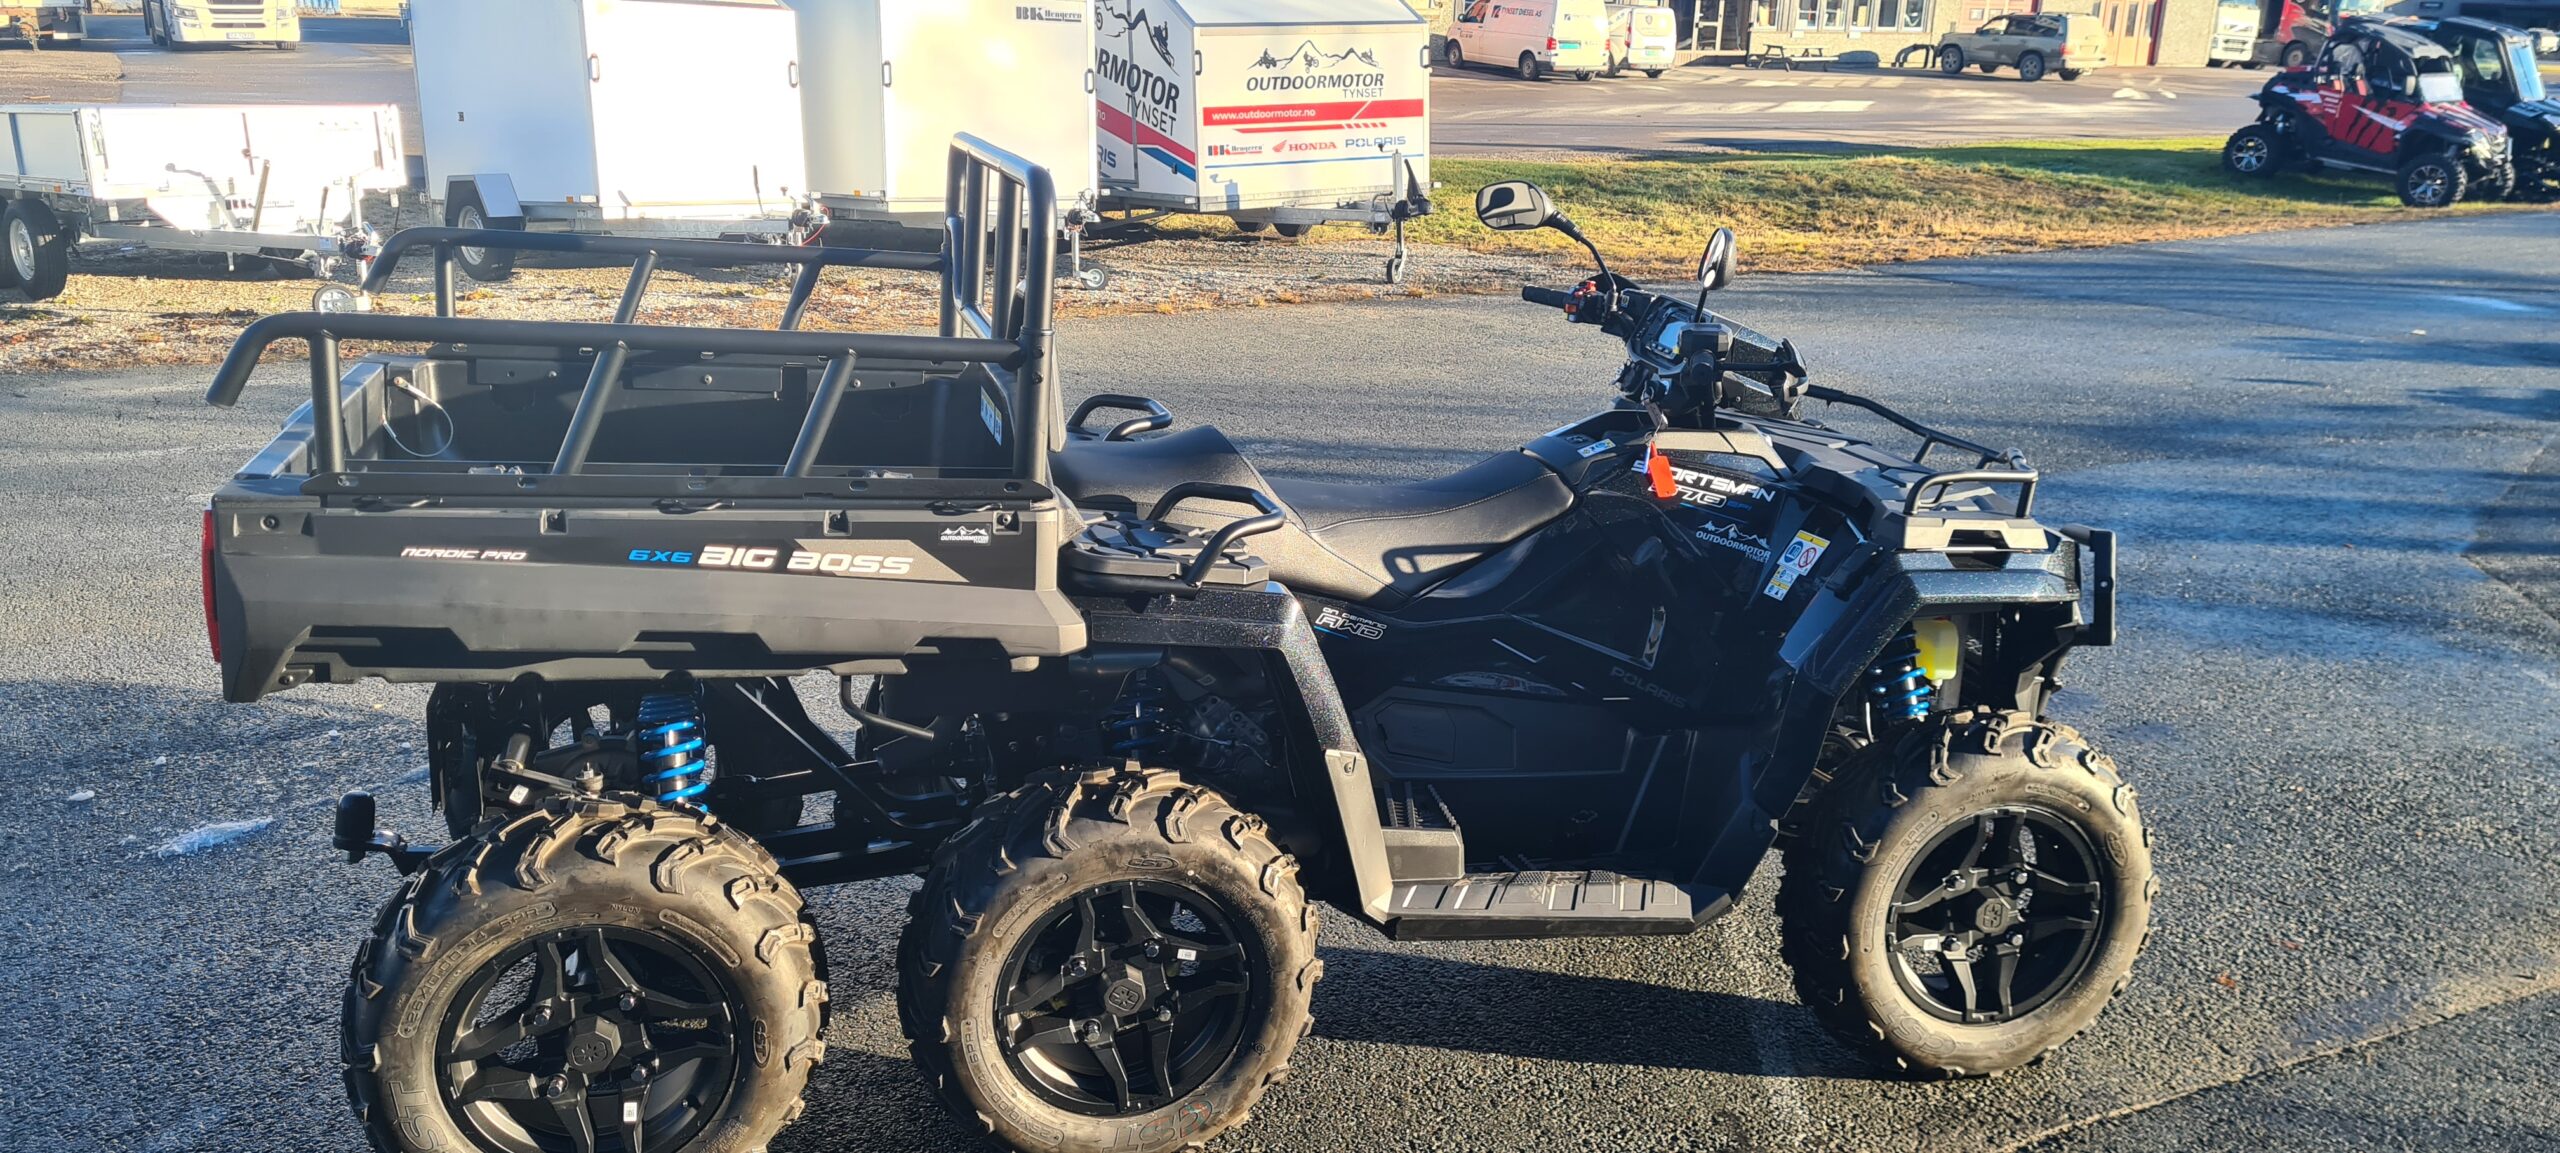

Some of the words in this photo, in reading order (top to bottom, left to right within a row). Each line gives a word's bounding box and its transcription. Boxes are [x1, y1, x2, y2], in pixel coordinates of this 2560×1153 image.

[1016, 6, 1044, 20] BK
[1095, 47, 1180, 115] RMOTOR
[1246, 73, 1384, 91] OUTDOORMOTOR
[1342, 87, 1383, 98] TYNSET
[1126, 92, 1177, 136] TYNSET
[1211, 108, 1316, 121] www.outdoormotor.no
[1207, 144, 1231, 156] BK
[1289, 141, 1337, 152] HONDA
[1345, 136, 1406, 148] POLARIS
[1631, 460, 1776, 502] SORTSMAN
[400, 547, 480, 559] NORDIC
[480, 550, 527, 561] PRO
[1695, 530, 1771, 558] OUTDOORMOTOR
[697, 545, 778, 567] BIG
[786, 550, 914, 574] BOSS
[1315, 612, 1383, 639] AWD
[1610, 665, 1688, 708] POLARIS
[389, 1081, 450, 1153] ST
